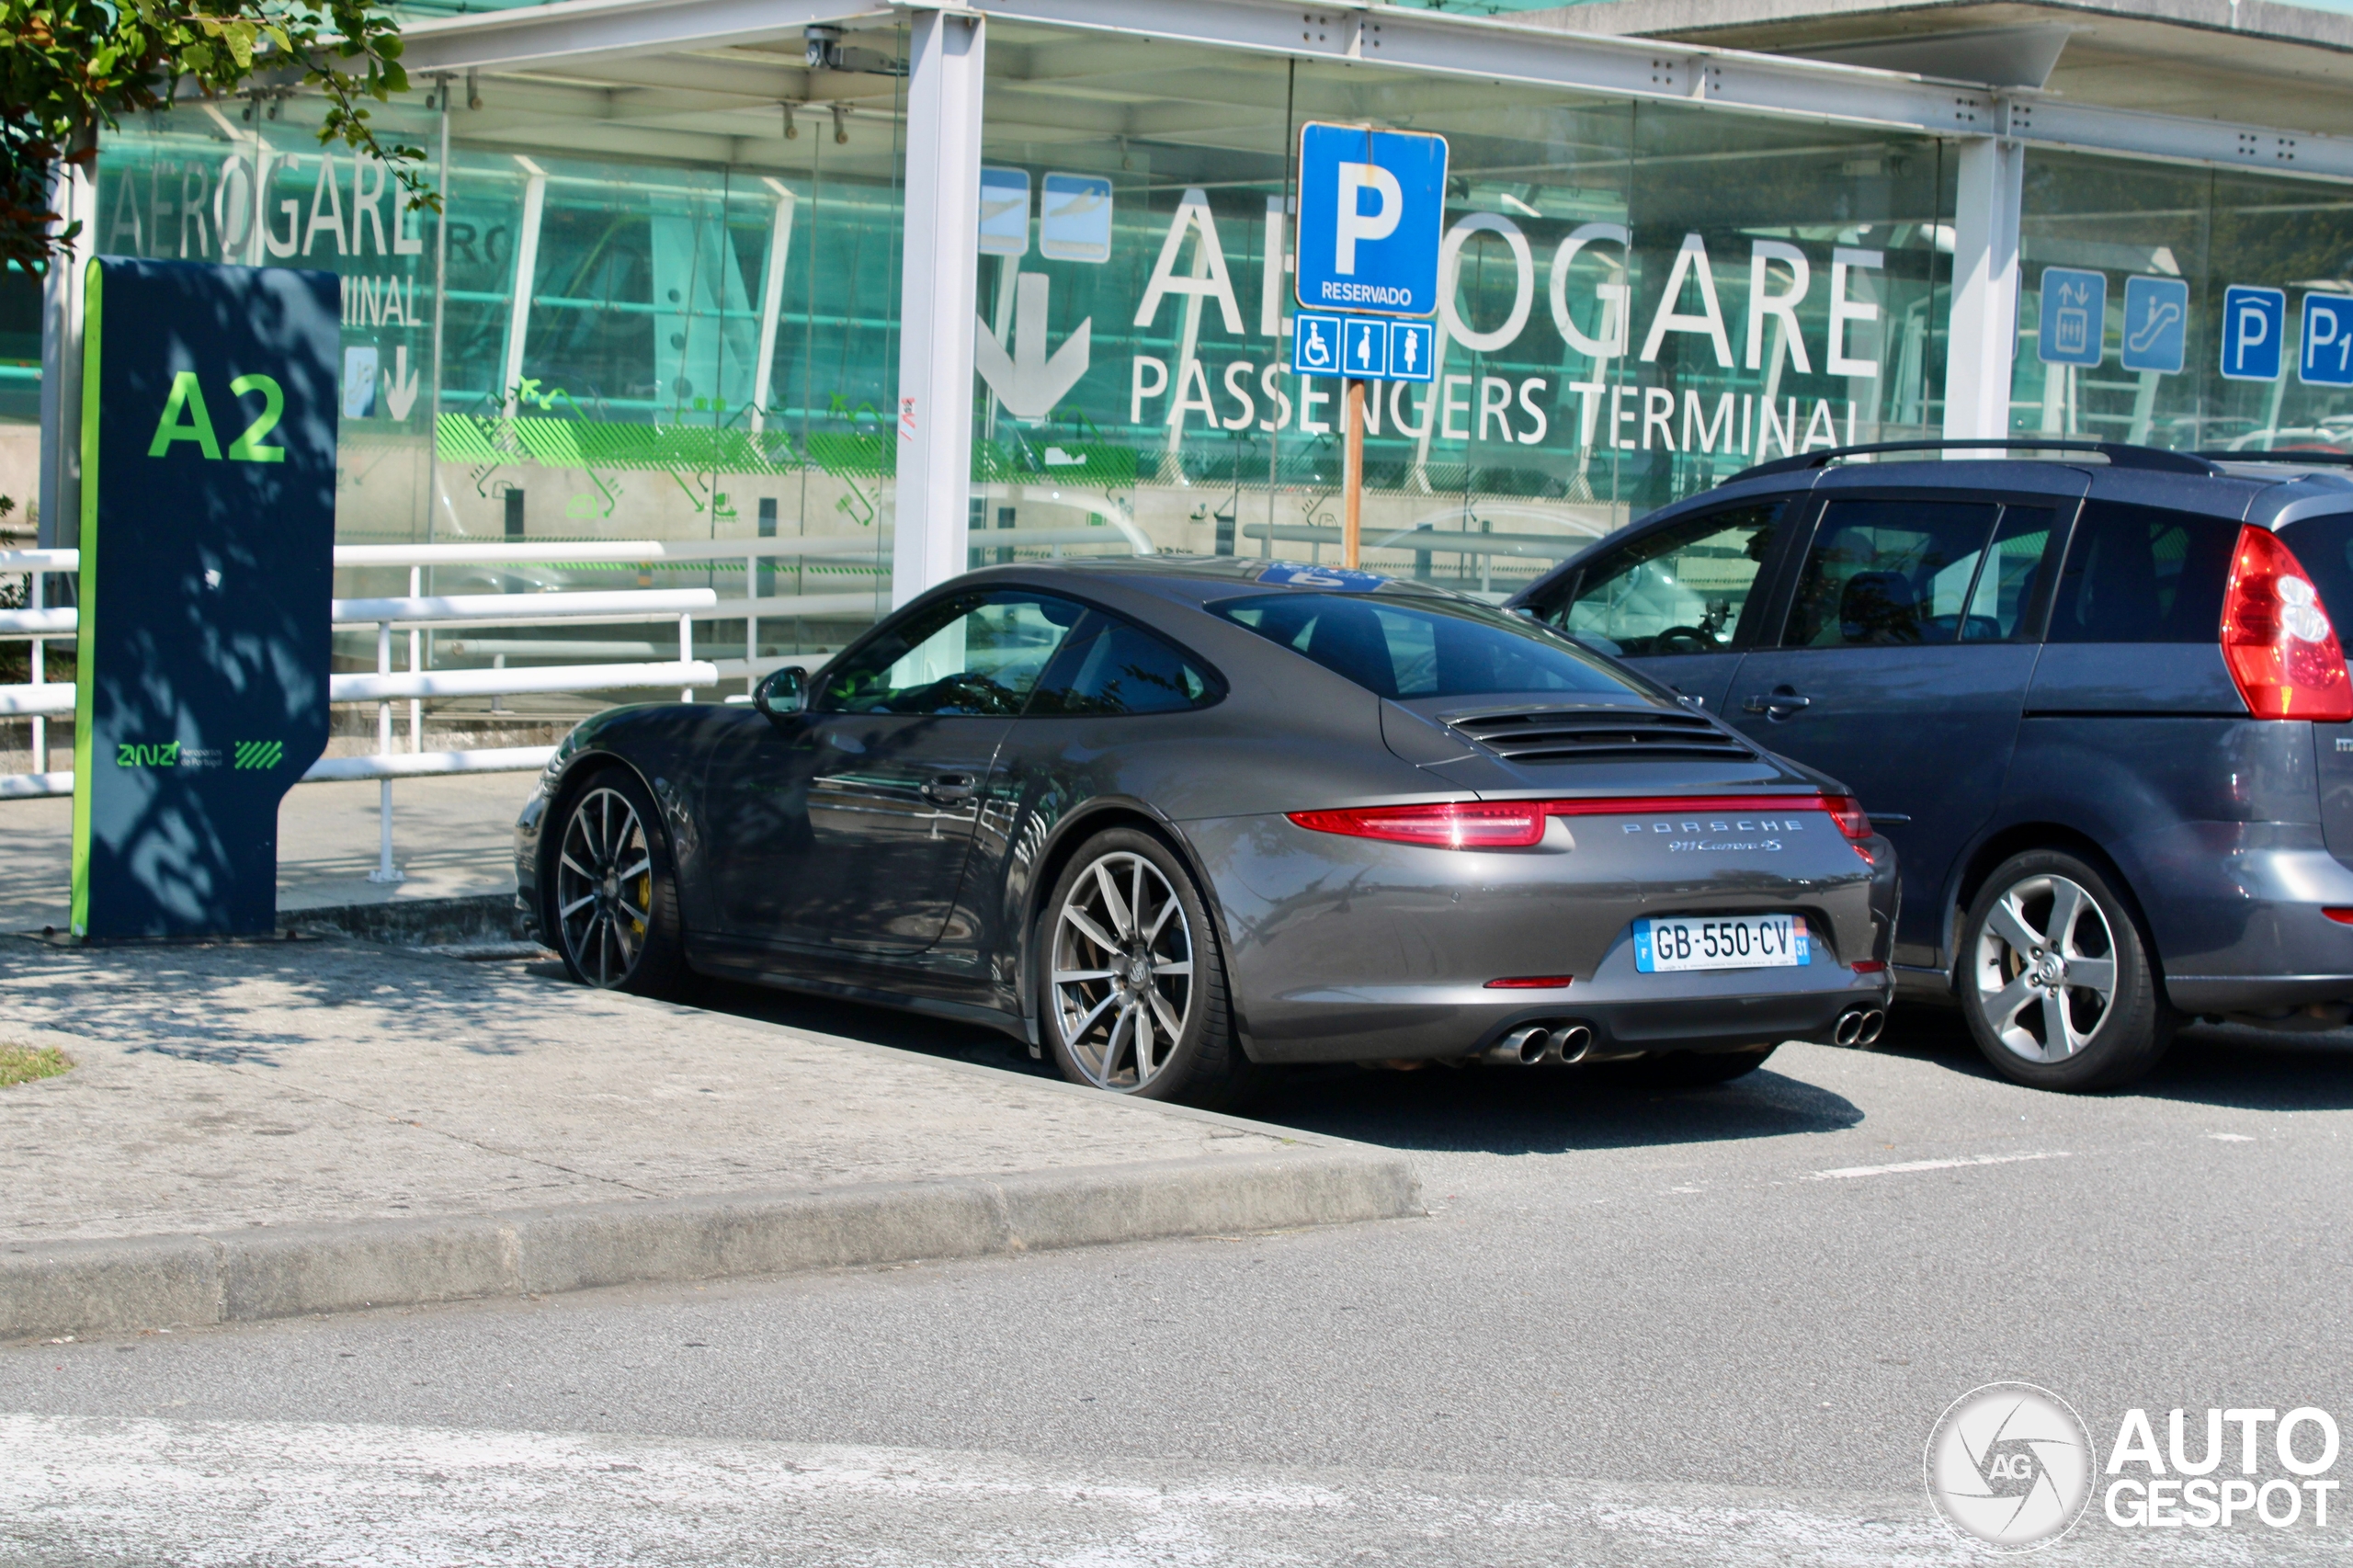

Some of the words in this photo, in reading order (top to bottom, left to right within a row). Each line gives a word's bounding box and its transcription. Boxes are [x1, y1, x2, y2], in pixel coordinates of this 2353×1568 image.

[108, 150, 424, 259] AEROGARE
[1336, 161, 1404, 275] P
[341, 275, 422, 327] INAL
[1133, 187, 1884, 378] AEOGARE
[1321, 280, 1413, 307] RESERVADO
[2236, 307, 2268, 370] P
[2307, 307, 2352, 371] P1
[148, 370, 285, 462] A2
[1131, 355, 1549, 446] PASSENGERS
[1568, 381, 1871, 463] TERMINAL
[1621, 820, 1803, 834] PORSCHE
[1669, 840, 1696, 852] 911
[1698, 839, 1758, 851] Carrera
[1760, 839, 1782, 852] 4S
[1641, 948, 1648, 960] F
[1656, 921, 1788, 960] GB-550-CV
[1796, 939, 1807, 956] 31
